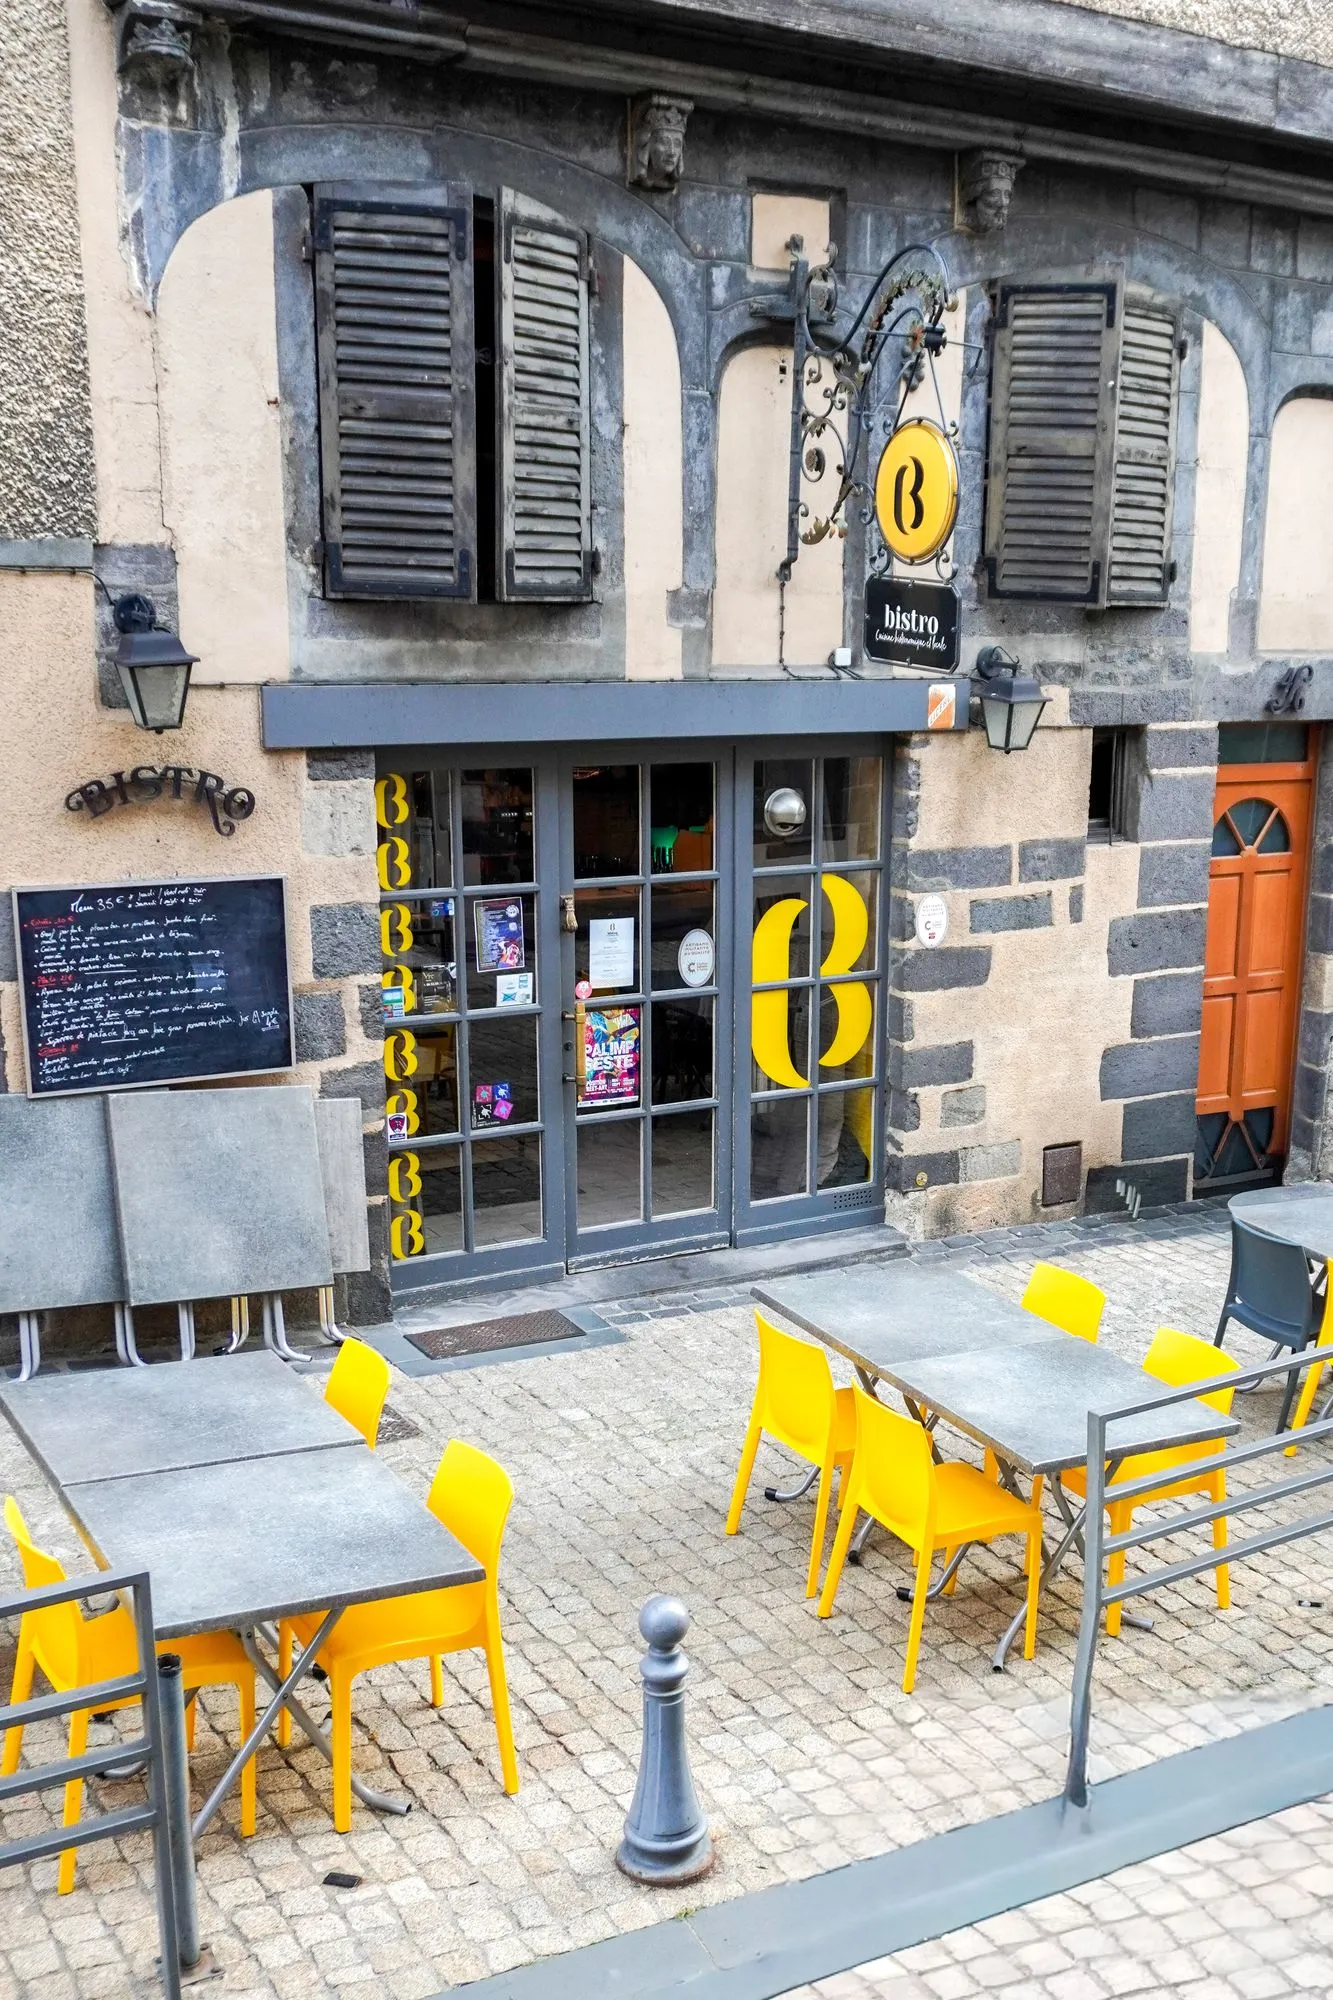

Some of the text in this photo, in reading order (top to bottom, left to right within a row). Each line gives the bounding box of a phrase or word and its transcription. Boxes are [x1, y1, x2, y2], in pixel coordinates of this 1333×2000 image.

[894, 456, 924, 535] B
[884, 604, 939, 635] bistro
[65, 766, 255, 837] BISTRO
